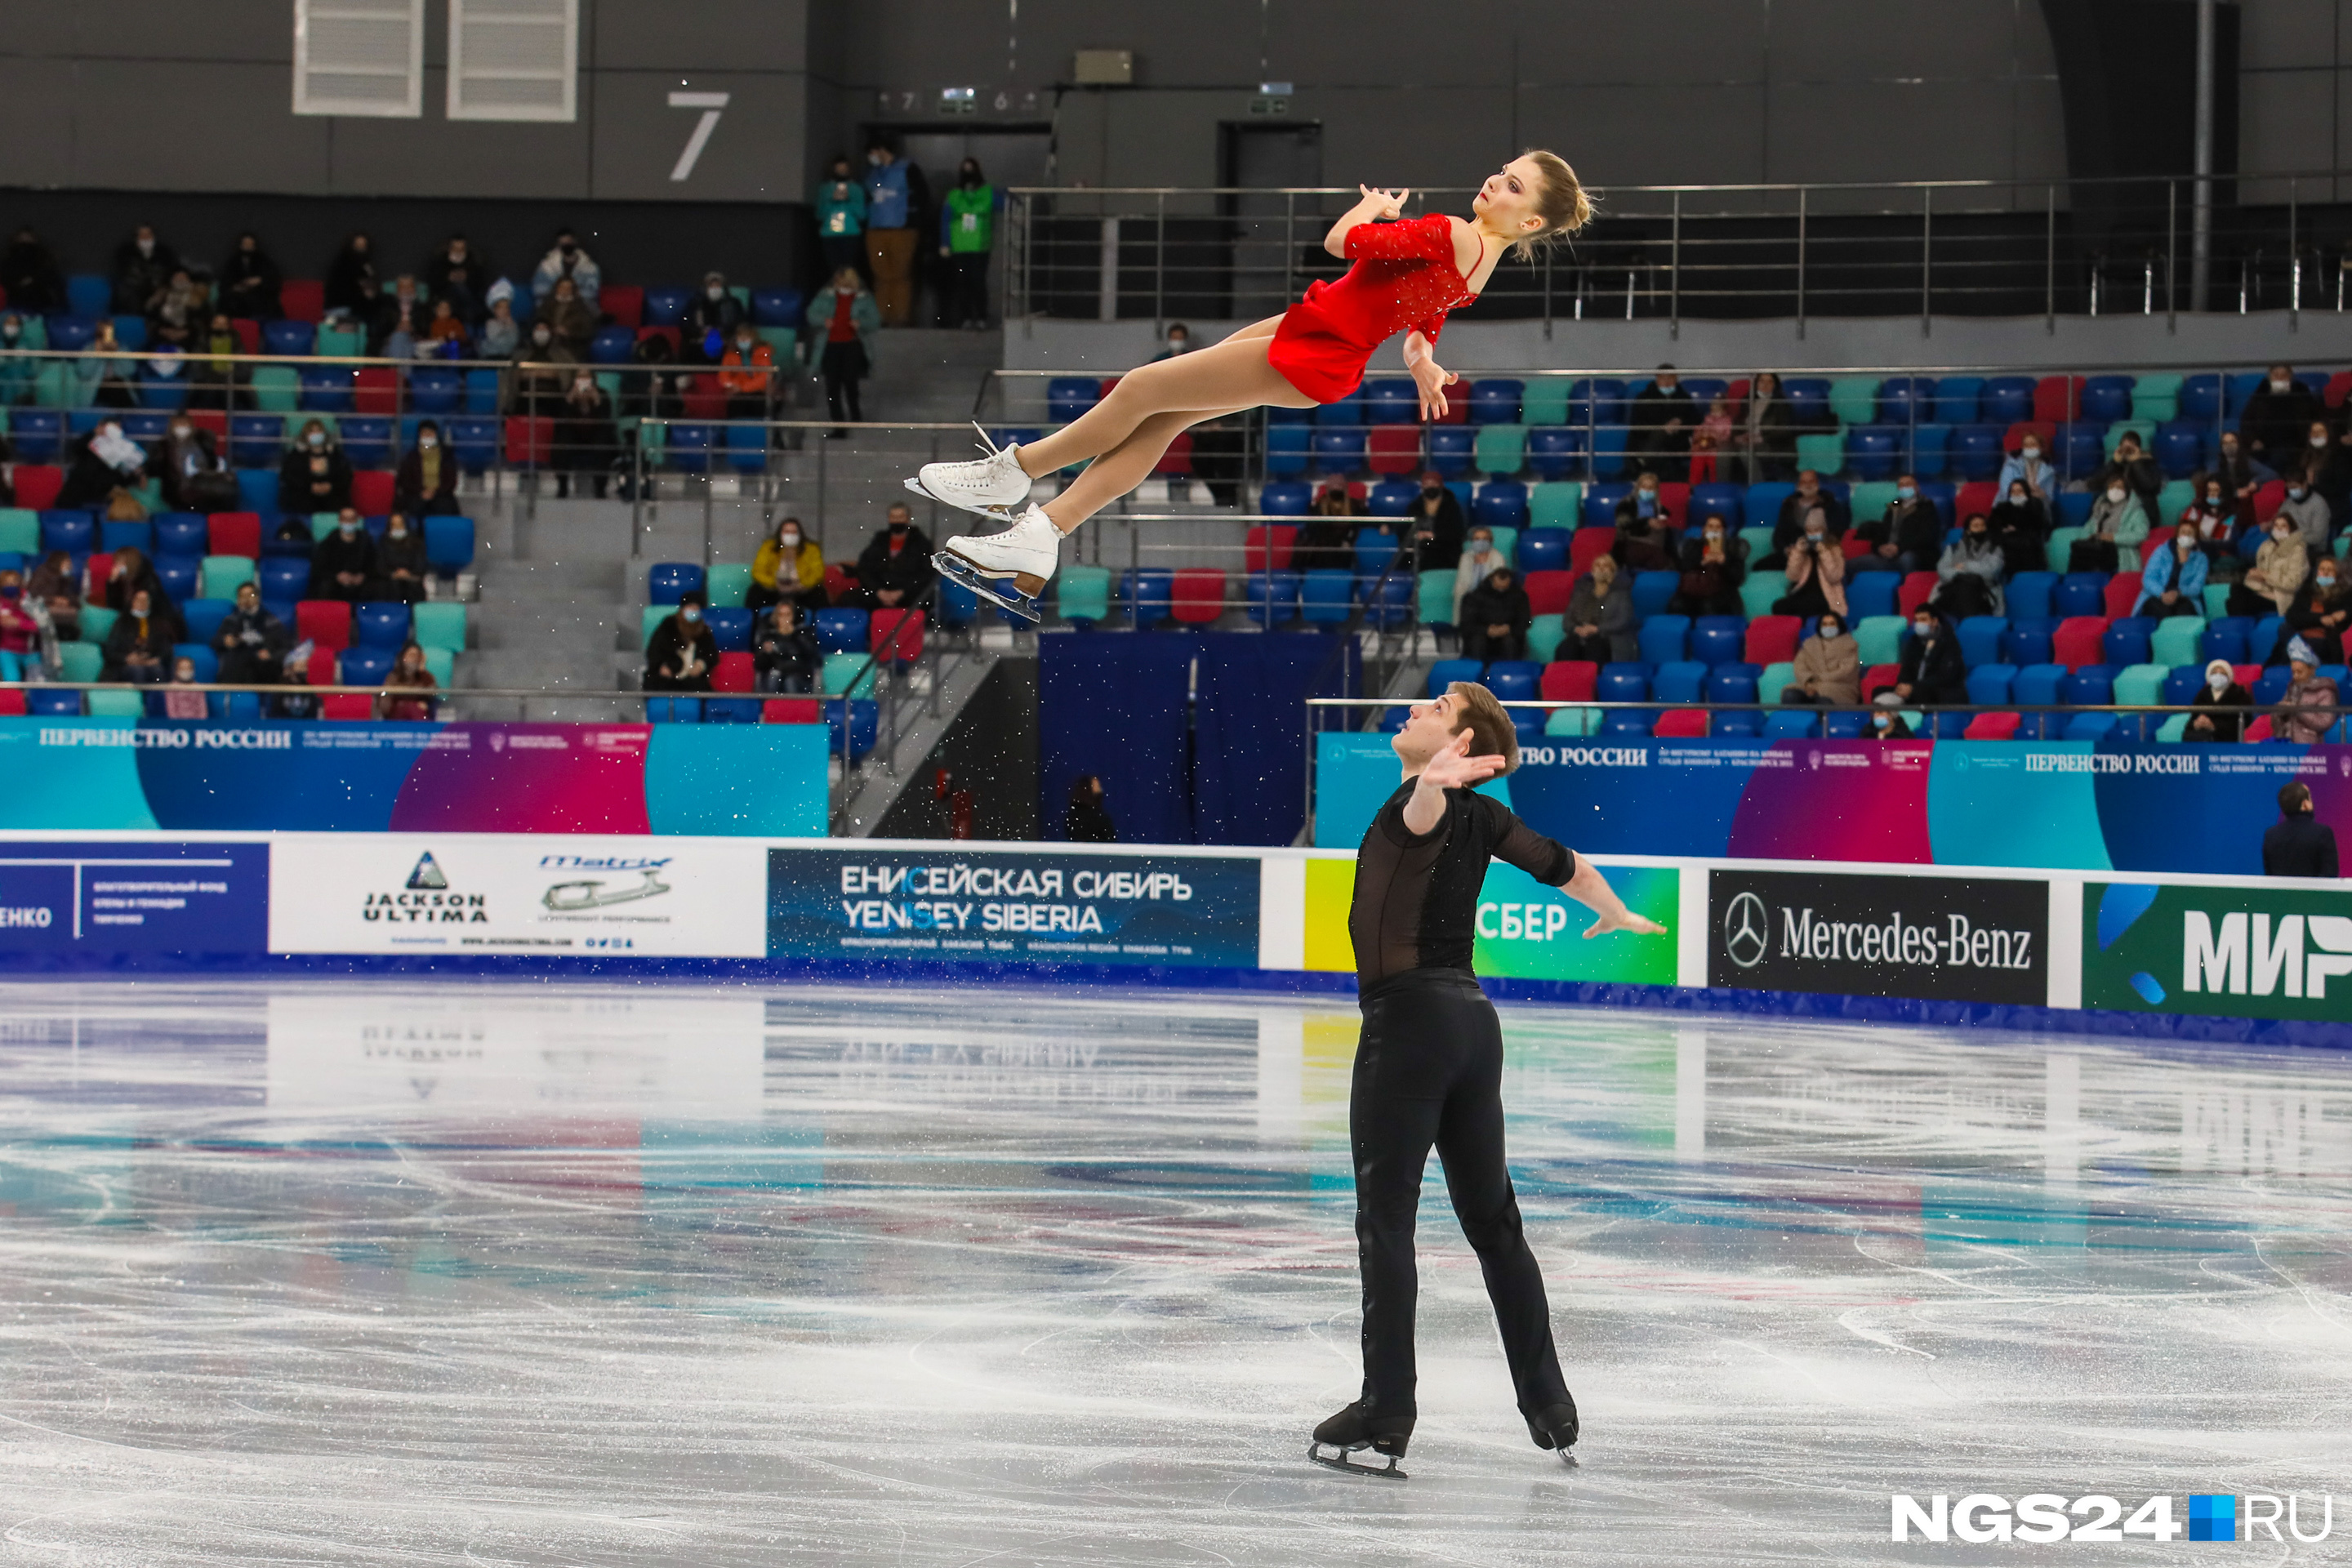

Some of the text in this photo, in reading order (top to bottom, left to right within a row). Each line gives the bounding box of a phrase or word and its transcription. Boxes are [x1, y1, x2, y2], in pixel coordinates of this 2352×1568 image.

[667, 91, 731, 181] 7
[39, 728, 189, 748] ПЕРВЕНСТВО
[194, 729, 292, 750] РОССИИ
[1560, 746, 1648, 767] РОССИИ
[2025, 753, 2132, 773] ПЕРВЕНСТВО
[2135, 754, 2200, 774] РОССИИ
[539, 855, 673, 869] Matrix
[840, 863, 1192, 901] ЕНИСЕЙСКАЯ СИБИРЬ
[365, 893, 486, 907] JACKSON
[363, 909, 489, 924] ULTIMA
[842, 900, 1103, 933] YENISEY SIBERIA
[1476, 902, 1567, 941] СБЕР
[1780, 906, 2032, 970] Mercedes-Benz
